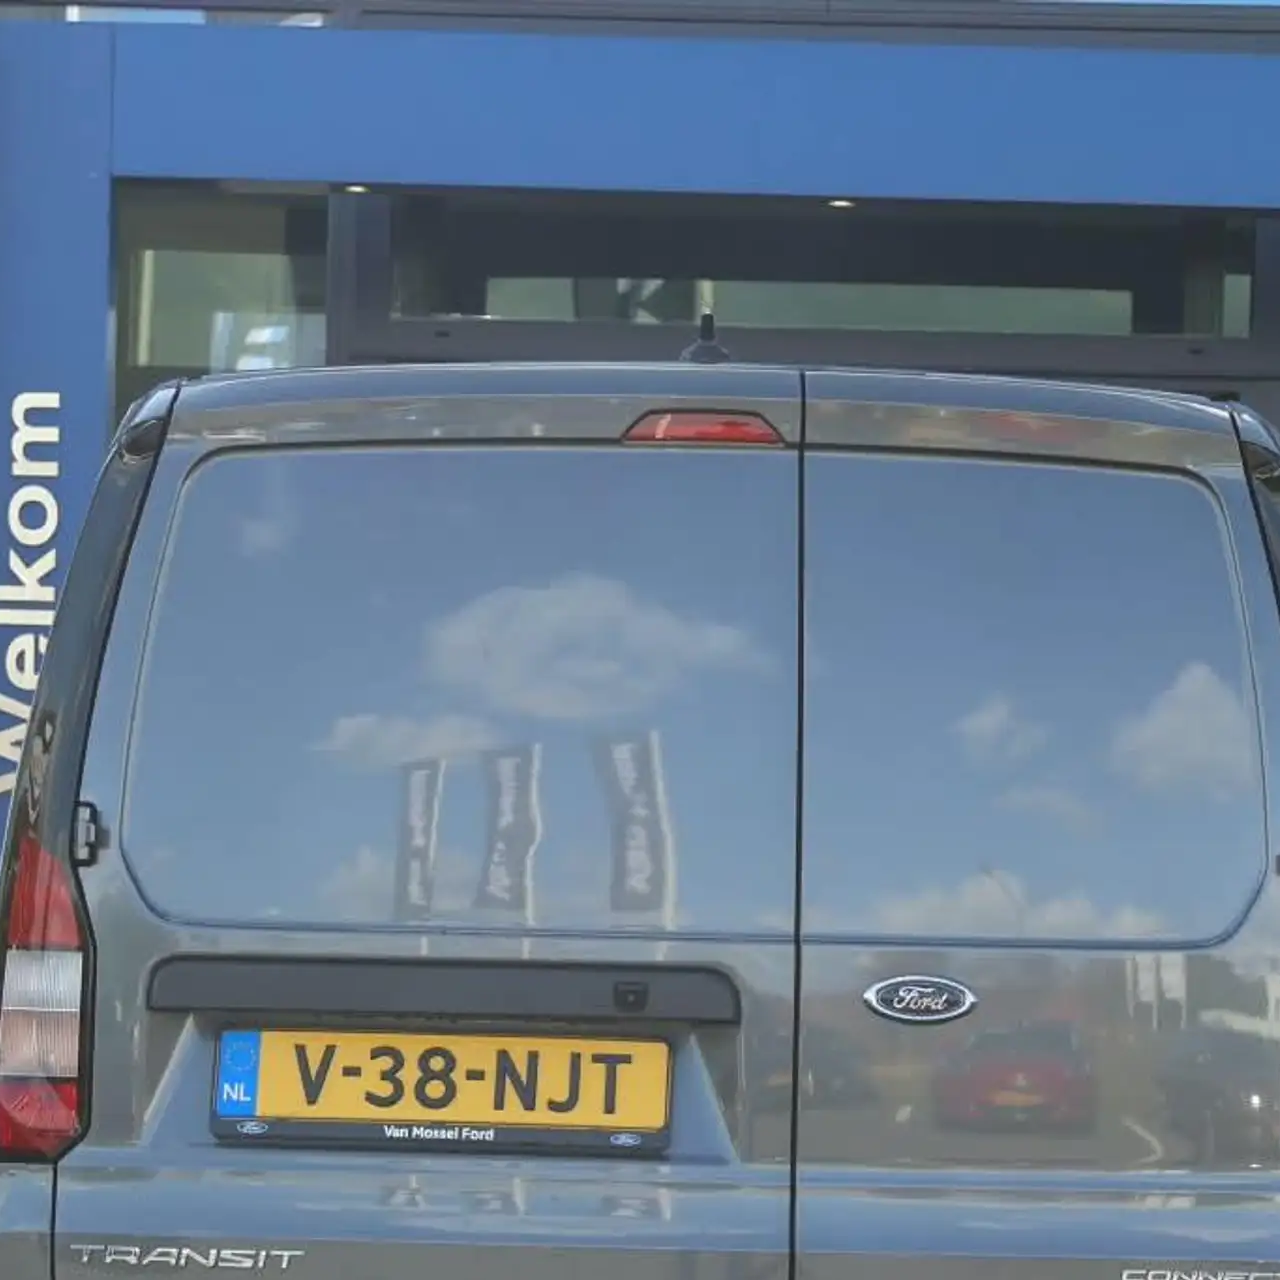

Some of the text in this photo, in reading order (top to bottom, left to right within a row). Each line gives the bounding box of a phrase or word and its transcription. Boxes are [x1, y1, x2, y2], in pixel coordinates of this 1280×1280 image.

[892, 985, 950, 1010] Ford
[223, 1081, 252, 1103] NL
[293, 1043, 633, 1116] V-38-NJT
[383, 1124, 496, 1141] Van Mossel Ford
[70, 1244, 306, 1269] TRANSIT
